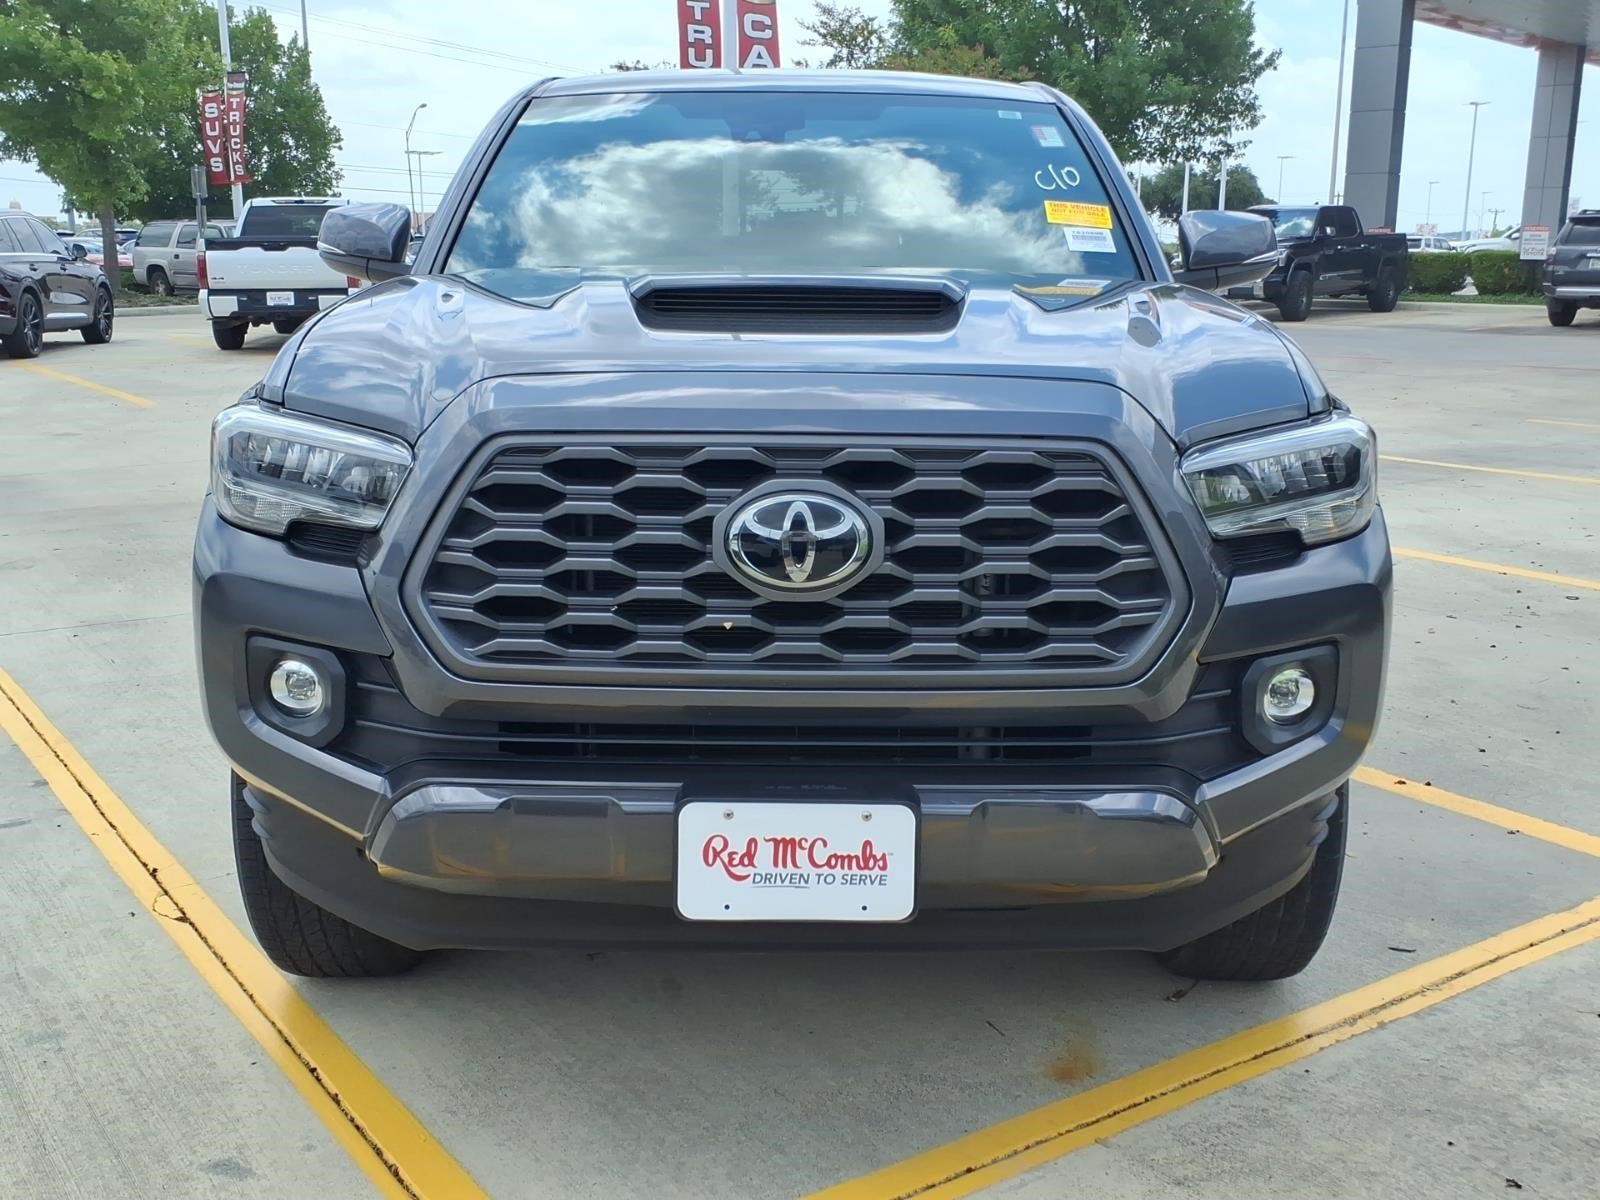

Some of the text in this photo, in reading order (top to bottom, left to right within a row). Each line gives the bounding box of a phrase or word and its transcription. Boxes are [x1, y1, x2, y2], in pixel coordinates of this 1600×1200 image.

[204, 102, 224, 173] SUVS
[229, 97, 245, 176] TRUCKS
[702, 833, 889, 882] Red McCombs
[751, 872, 889, 887] DRIVEN TO SERVE
